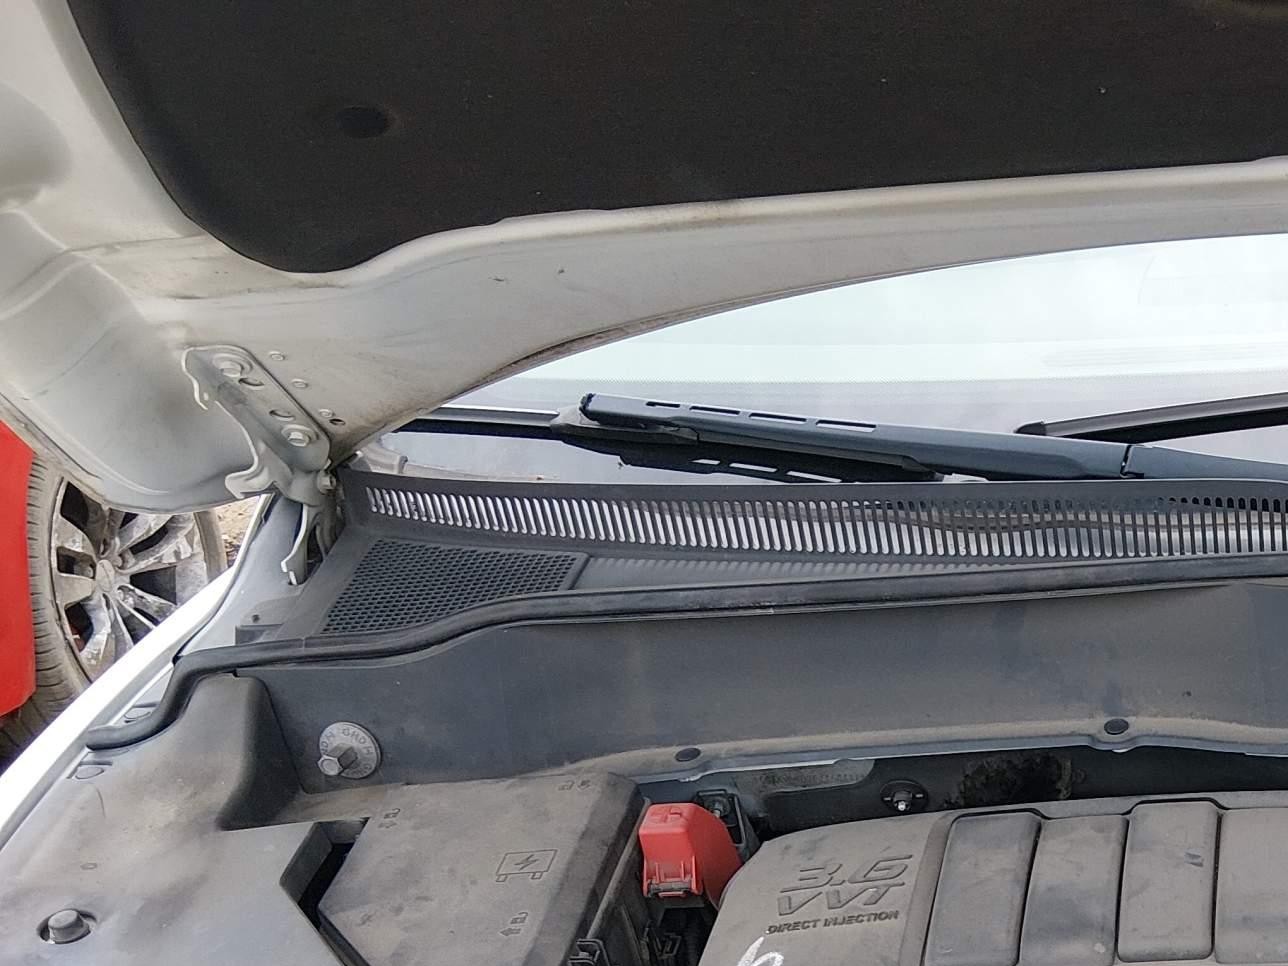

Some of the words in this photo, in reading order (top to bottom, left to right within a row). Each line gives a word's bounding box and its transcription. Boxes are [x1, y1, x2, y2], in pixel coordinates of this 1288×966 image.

[780, 854, 913, 893] 3.6
[777, 880, 906, 917] VVT
[767, 917, 820, 935] DIRECT
[823, 909, 899, 927] INJECTION
